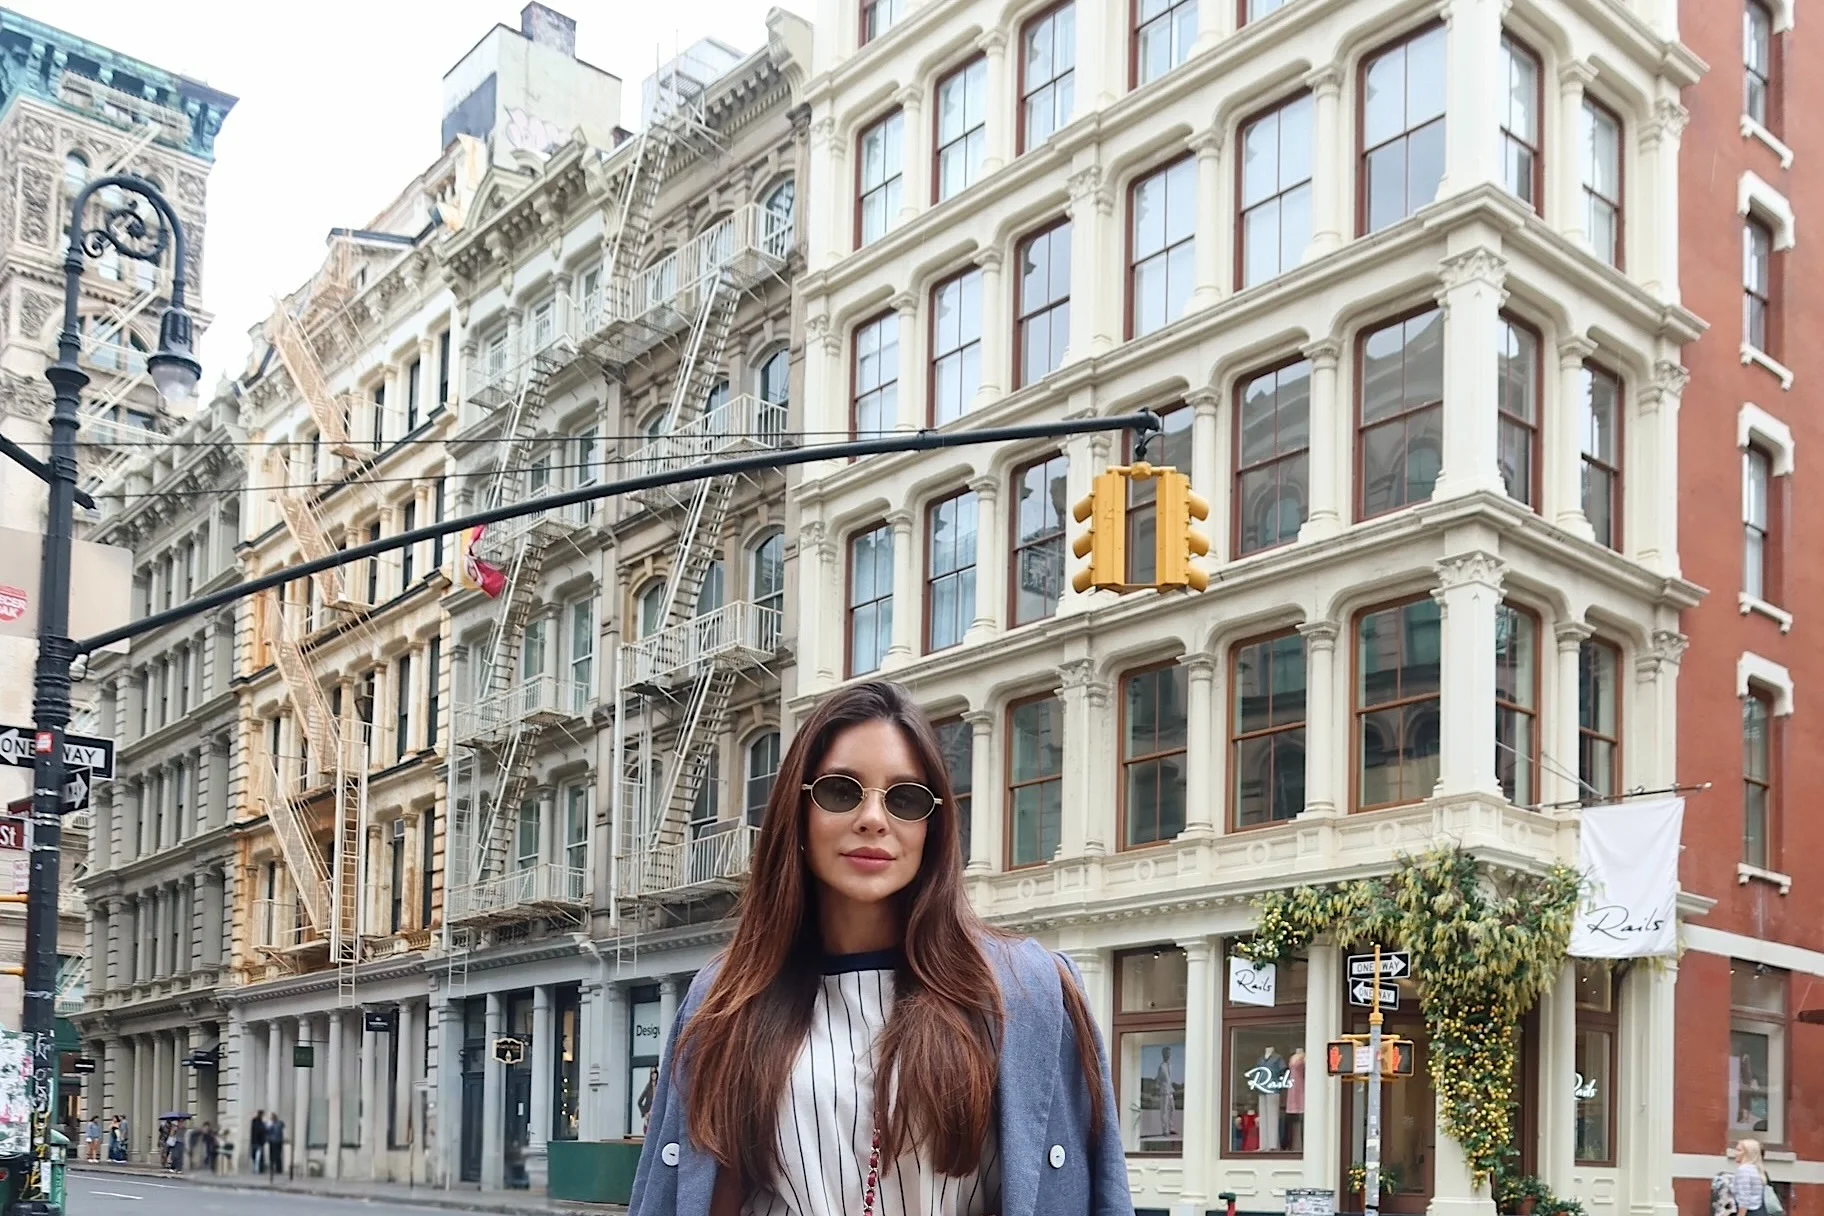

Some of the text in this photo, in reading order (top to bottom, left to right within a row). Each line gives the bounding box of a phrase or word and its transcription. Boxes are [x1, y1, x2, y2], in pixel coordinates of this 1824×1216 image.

[1, 738, 36, 757] ONE
[0, 825, 16, 847] St
[1585, 905, 1664, 941] Rails
[1357, 961, 1399, 973] ONE WAY
[1235, 969, 1272, 994] Rails
[1359, 987, 1373, 998] ONE
[1244, 1066, 1295, 1094] Rails
